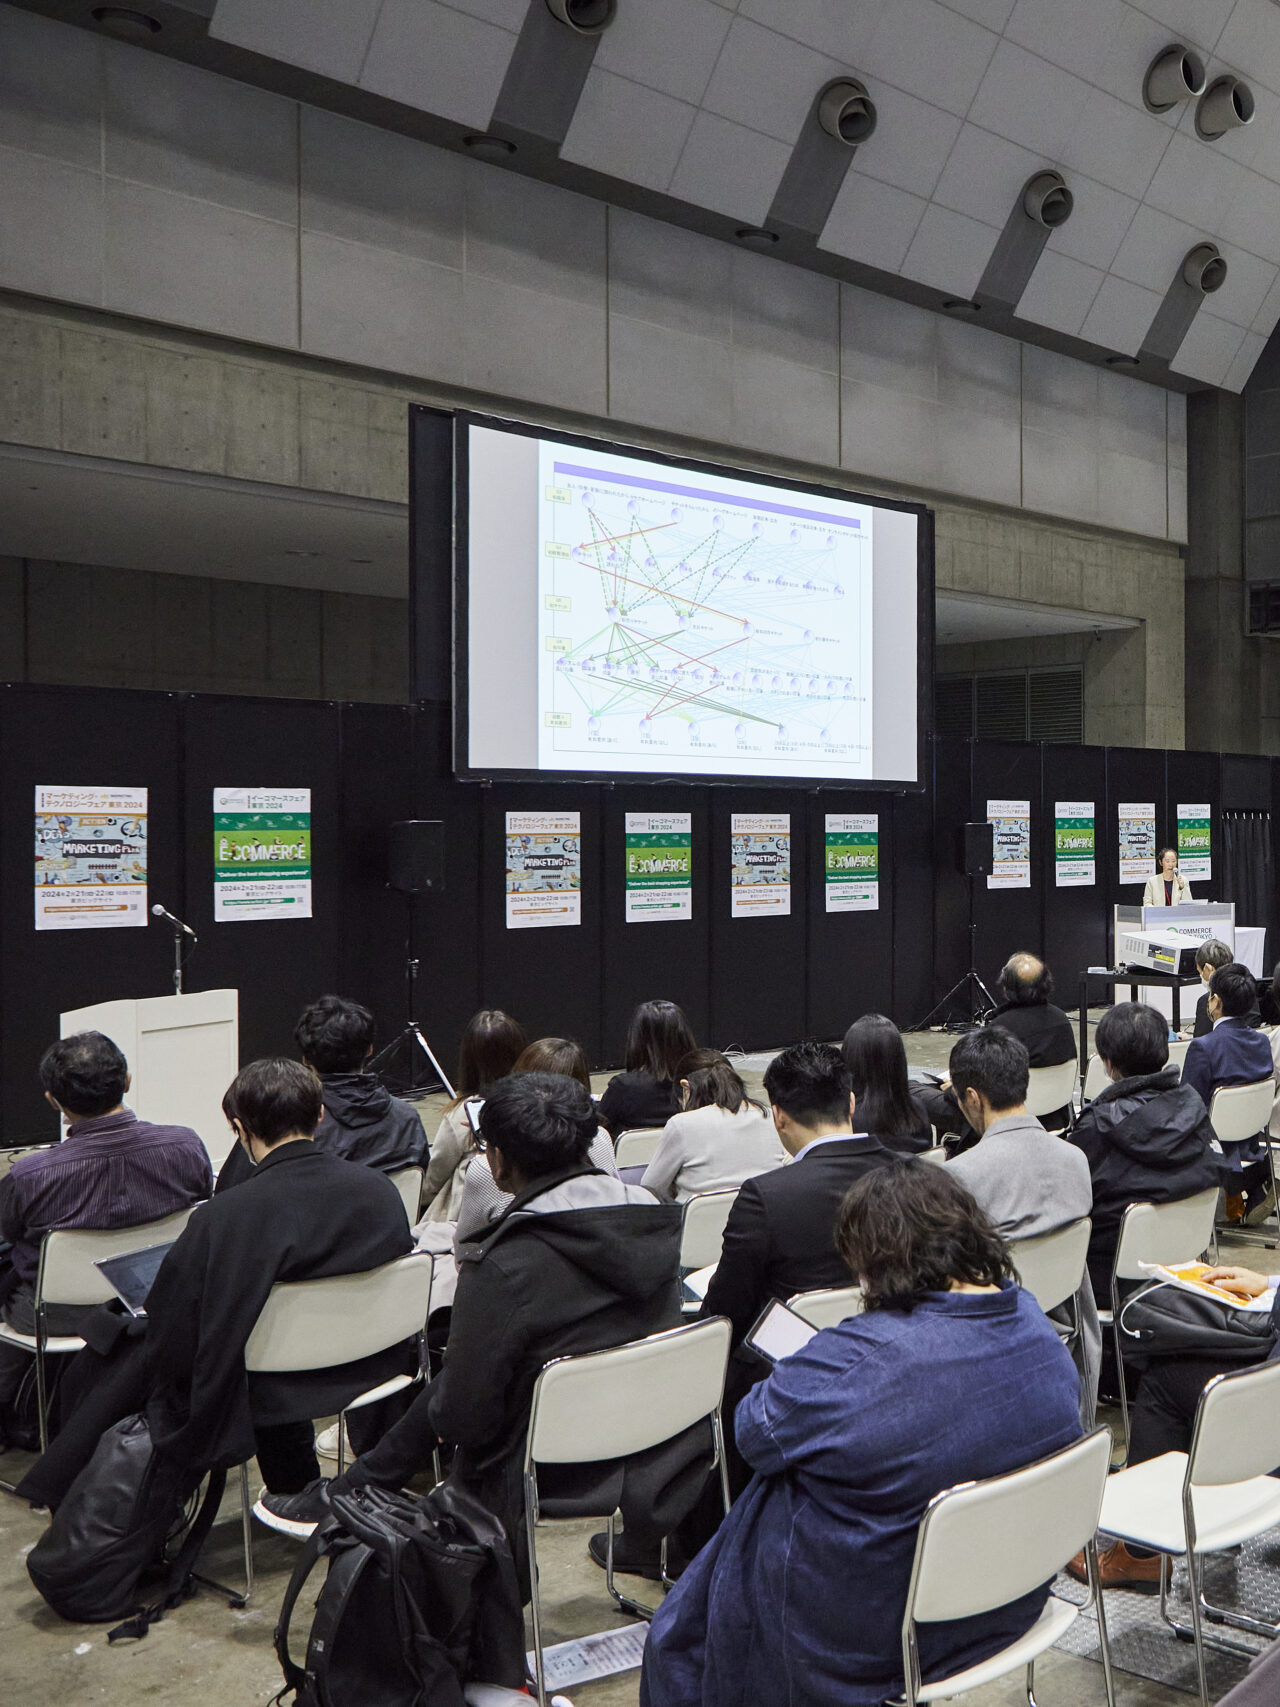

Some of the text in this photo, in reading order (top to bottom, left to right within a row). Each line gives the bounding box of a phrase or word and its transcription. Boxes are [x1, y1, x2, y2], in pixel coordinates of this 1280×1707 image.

[124, 801, 143, 809] 2024
[63, 842, 121, 854] MARKETING
[219, 844, 306, 861] E-COMMERCE
[524, 858, 563, 867] MARKETING
[745, 855, 777, 863] MARKETING
[828, 855, 875, 868] E-COMMERCE
[629, 859, 688, 873] E-COMMERCE
[1178, 927, 1212, 935] COMMERCE
